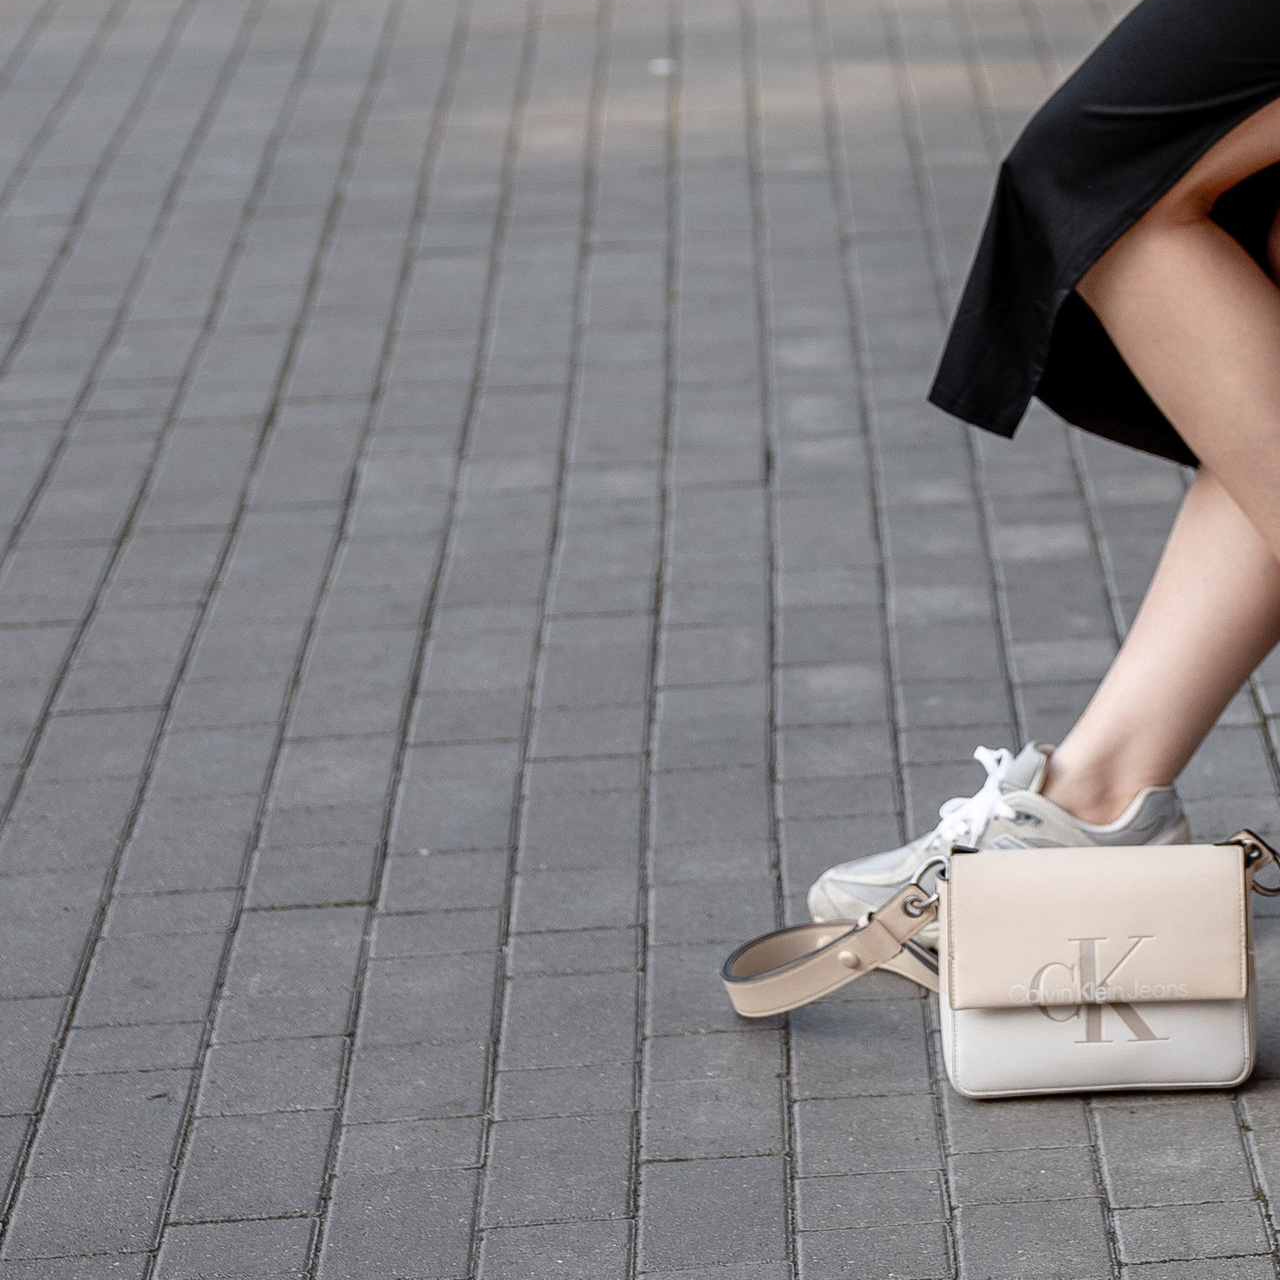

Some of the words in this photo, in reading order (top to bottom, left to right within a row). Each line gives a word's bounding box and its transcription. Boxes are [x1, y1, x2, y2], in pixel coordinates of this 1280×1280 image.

[1008, 981, 1073, 1004] Calvin
[1077, 981, 1125, 1003] Klein
[1128, 980, 1189, 1000] Jeans
